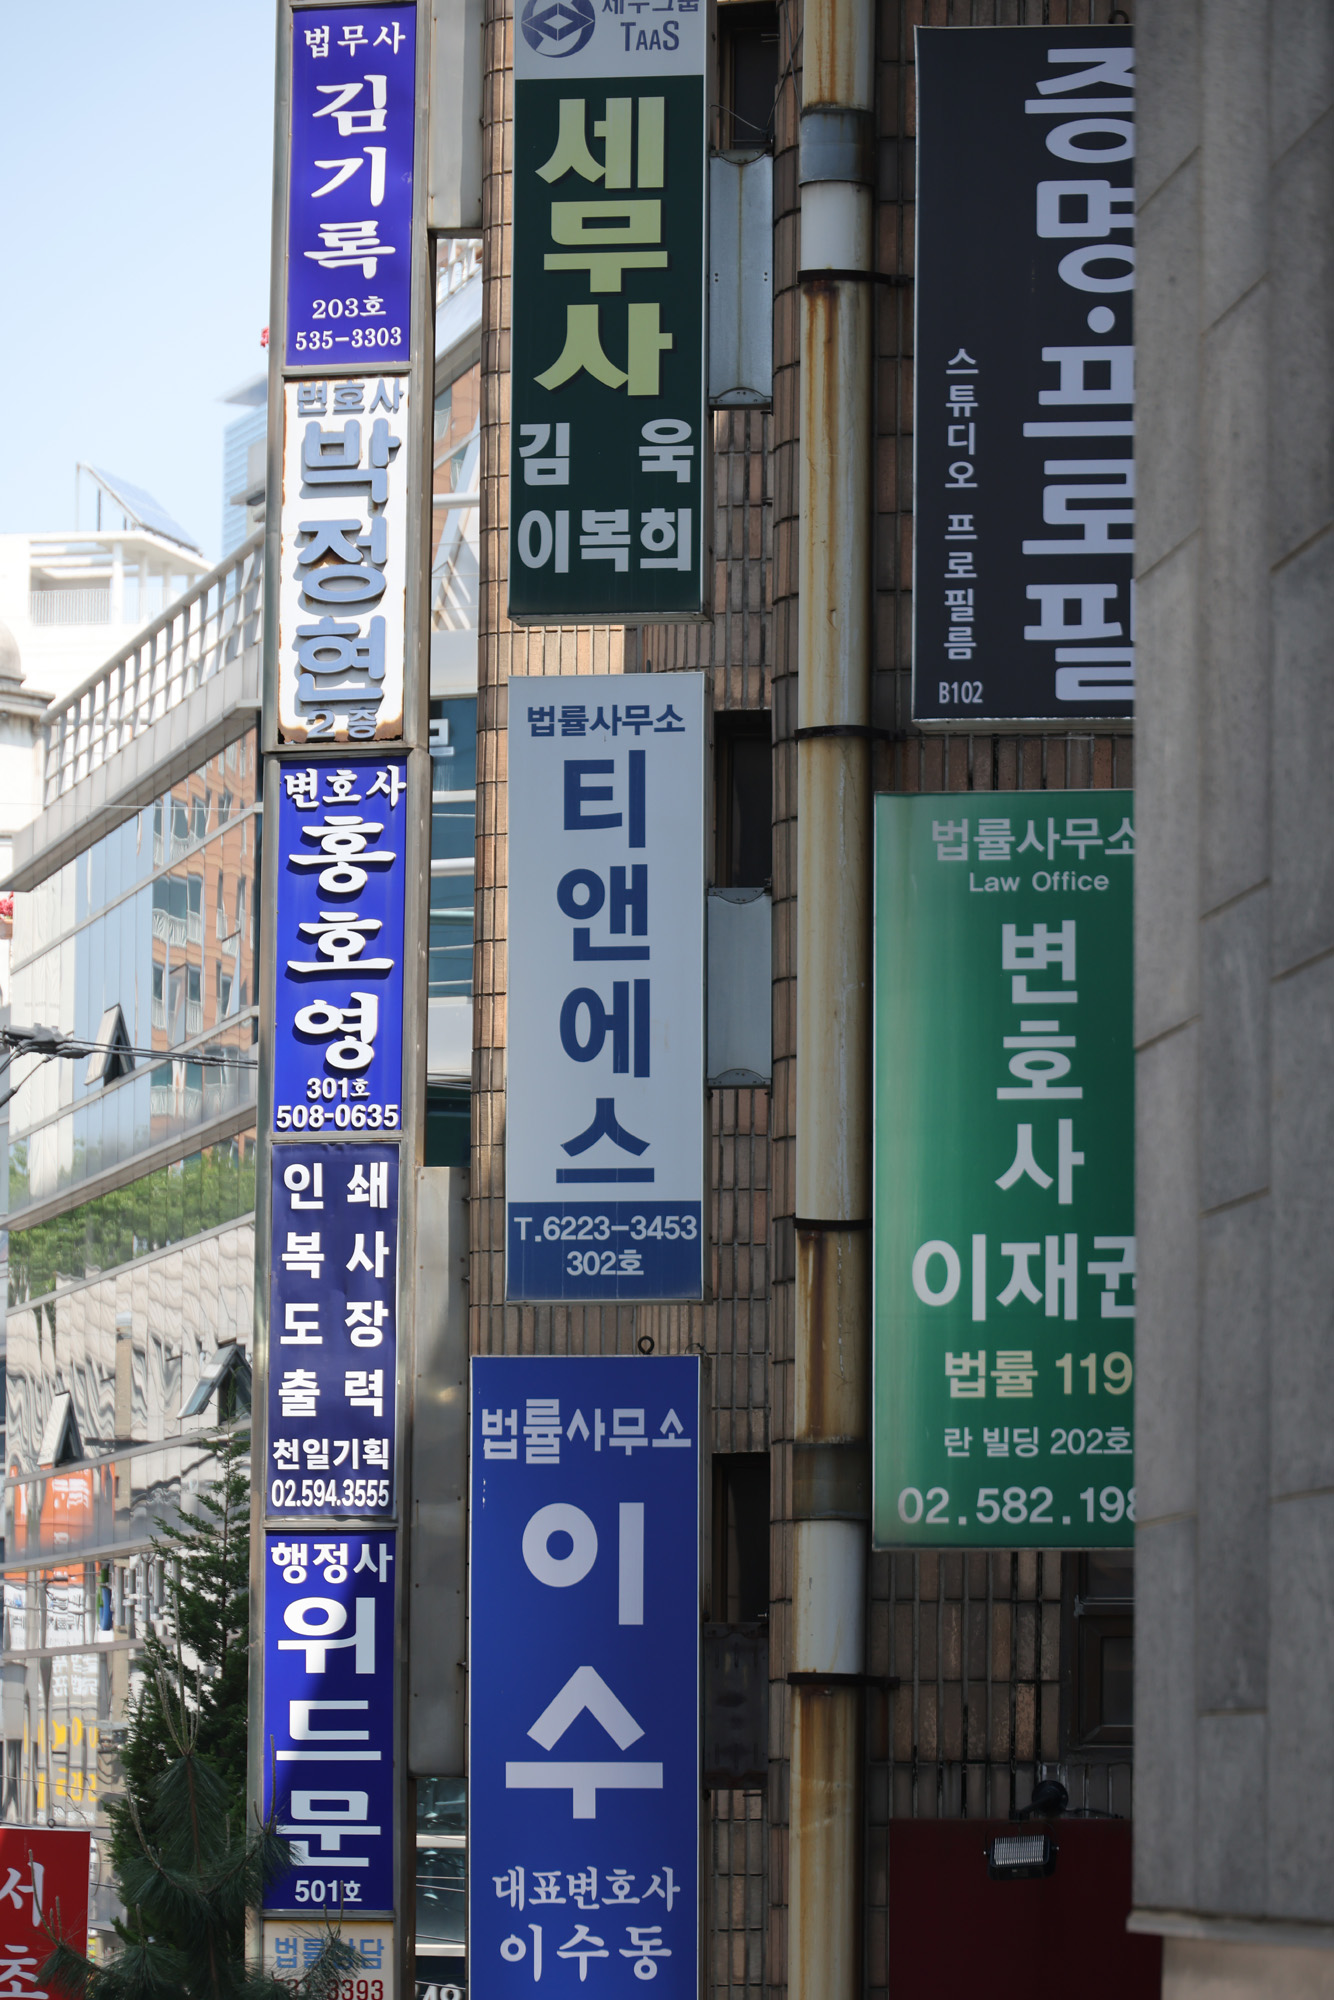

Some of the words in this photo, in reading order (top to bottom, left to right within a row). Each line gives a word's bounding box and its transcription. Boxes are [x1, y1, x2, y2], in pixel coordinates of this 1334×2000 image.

[304, 21, 406, 59] 법무사
[303, 74, 396, 279] 김기록
[533, 96, 673, 396] 세무사
[312, 295, 387, 319] 203호
[295, 326, 402, 350] 535-3303
[297, 379, 405, 416] 변호사
[945, 348, 979, 488] 스튜디오
[297, 417, 401, 703] 박정현
[517, 507, 693, 574] 이복희
[944, 514, 978, 660] 프로필름
[938, 680, 983, 704] B102
[526, 704, 686, 738] 법률사무소
[284, 765, 407, 809] 변호사
[969, 871, 1021, 892] Law
[1032, 871, 1110, 892] Office
[287, 815, 397, 1070] 홍호영
[556, 749, 655, 1183] 티앤에스
[995, 920, 1085, 1205] 변호사
[306, 1077, 371, 1100] 301호
[276, 1103, 399, 1129] 508-0635
[566, 1249, 644, 1277] 302호
[945, 1350, 1039, 1398] 법률
[1055, 1351, 1134, 1395] 119
[481, 1398, 692, 1465] 법률사무소
[1050, 1426, 1134, 1455] 202호
[272, 1438, 389, 1471] 천일기획
[270, 1479, 390, 1507] 02.594.3555
[270, 1542, 393, 1584] 행정사
[505, 1502, 664, 1819] 이수
[275, 1596, 382, 1868] 위드문
[294, 1879, 362, 1903] 501호
[492, 1865, 681, 1913] 대표변호사
[499, 1923, 673, 1983] 이수동
